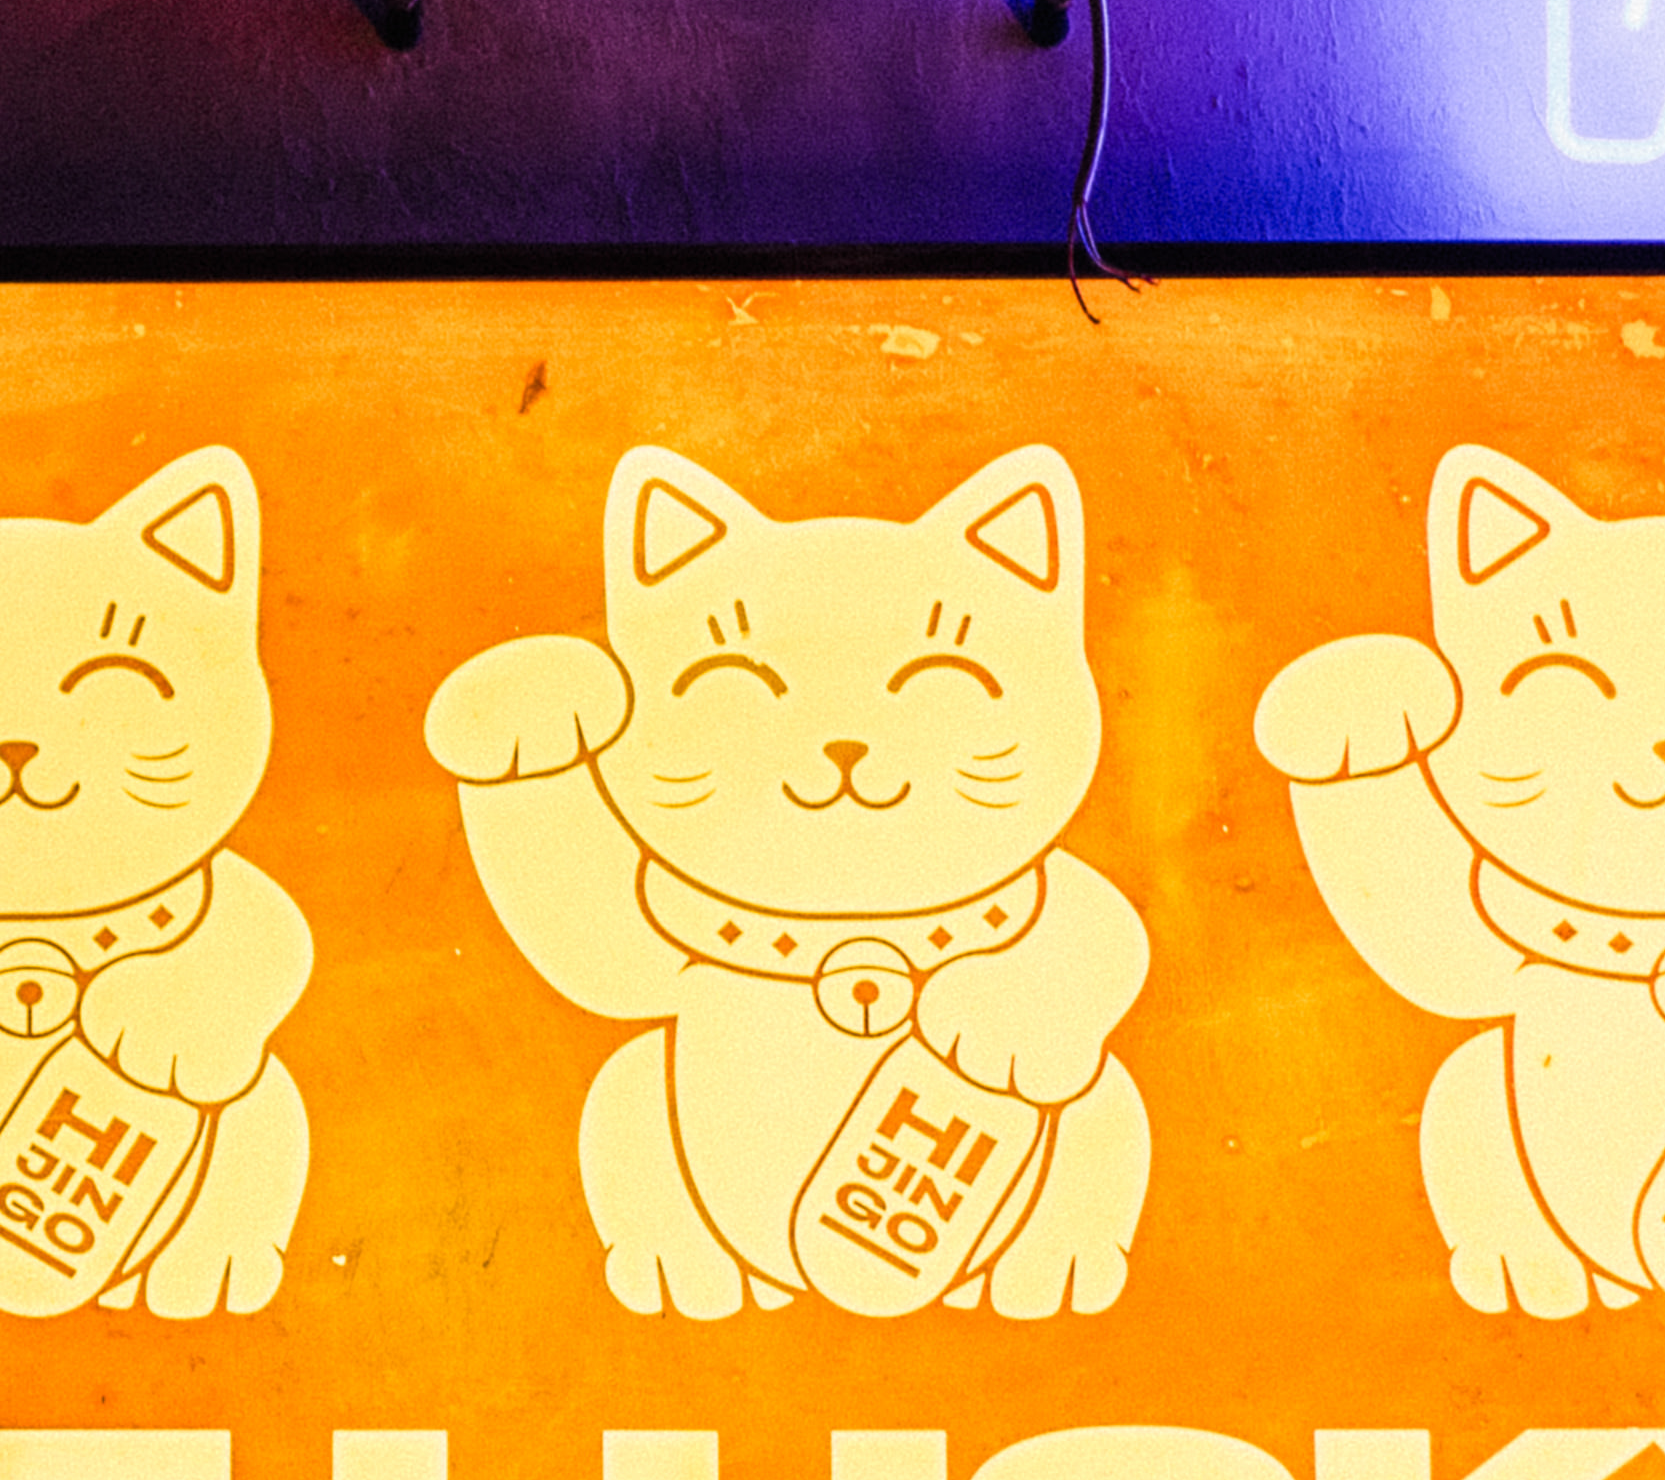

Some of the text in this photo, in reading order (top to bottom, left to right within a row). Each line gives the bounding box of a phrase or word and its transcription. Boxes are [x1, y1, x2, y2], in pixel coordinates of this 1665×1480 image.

[35, 1087, 158, 1188] HI
[875, 1086, 999, 1187] HI
[16, 1143, 124, 1225] JIN
[835, 1182, 939, 1255] GO
[856, 1142, 964, 1223] JIN
